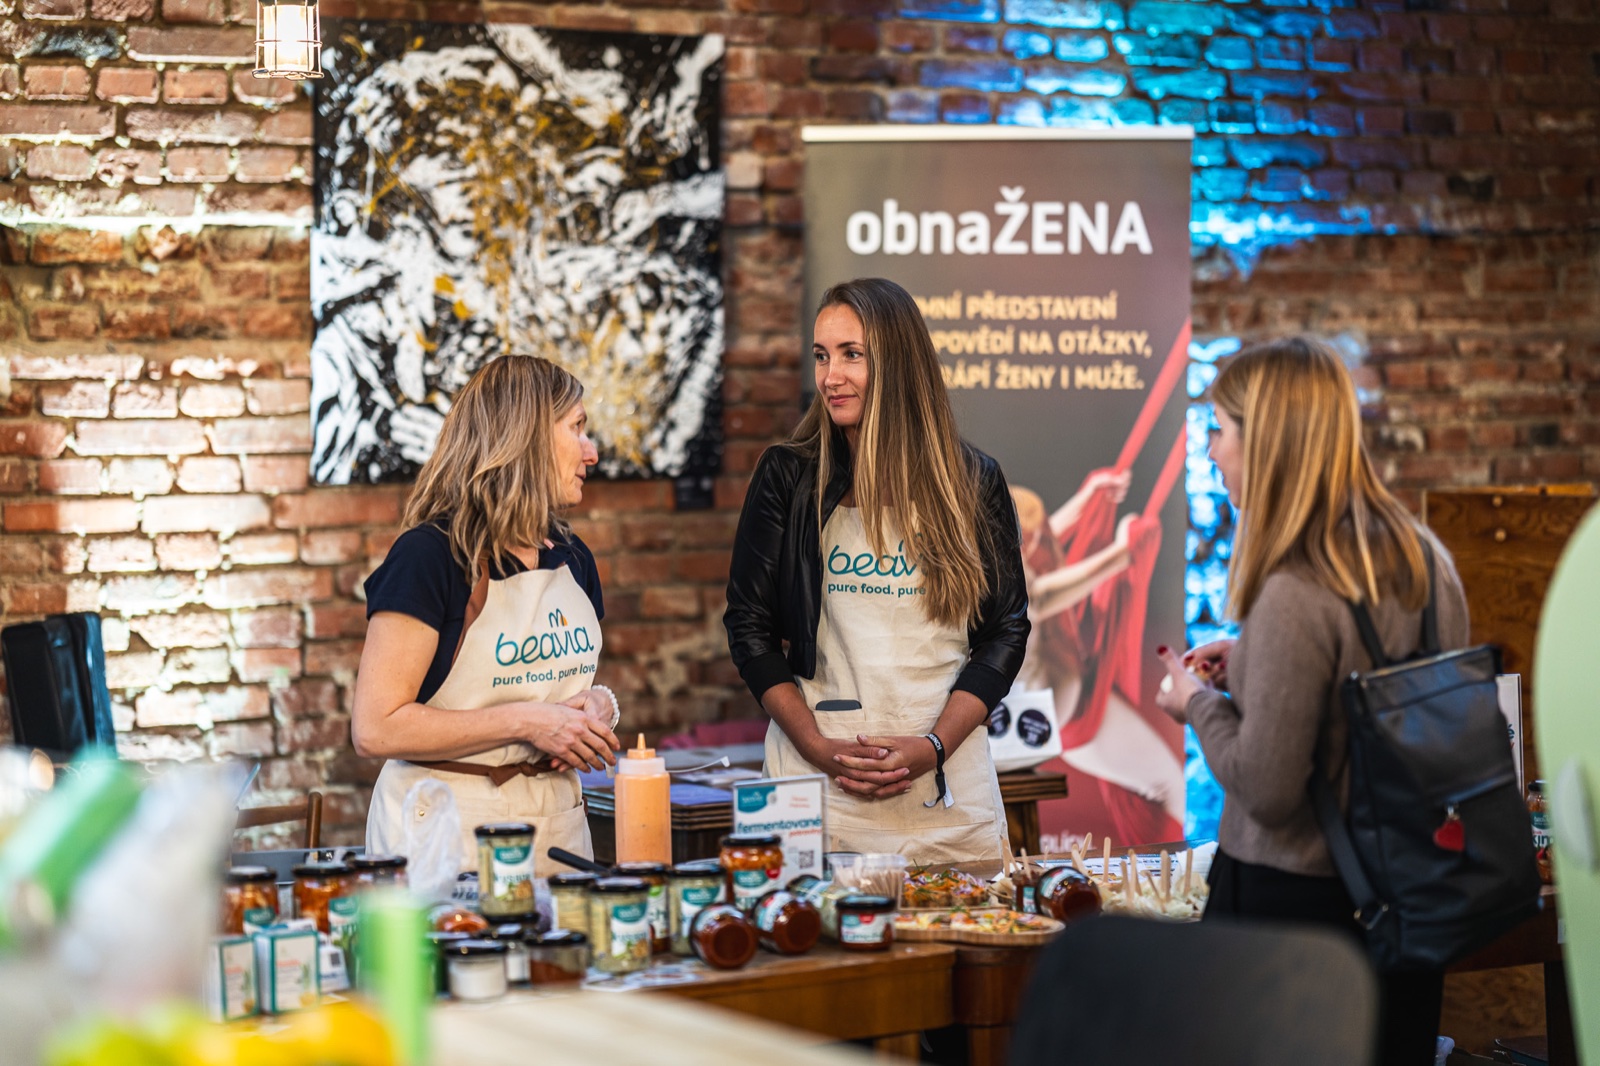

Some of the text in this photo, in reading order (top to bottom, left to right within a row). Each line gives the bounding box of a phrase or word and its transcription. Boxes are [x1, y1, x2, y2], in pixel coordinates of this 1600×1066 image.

[846, 185, 1153, 255] obnaŽENA
[966, 290, 1118, 320] PŘEDSTAVENÍ
[931, 325, 1152, 358] POVĚDÍ NA OTÁZKY,
[995, 359, 1056, 389] ŽENY
[1061, 365, 1069, 389] I
[1075, 359, 1145, 389] MUŽE.
[828, 583, 857, 594] pure
[861, 583, 894, 595] food.
[495, 627, 594, 667] beavia
[492, 675, 523, 688] pure
[526, 669, 556, 683] food.
[558, 667, 578, 682] pure
[737, 815, 822, 834] fermentované
